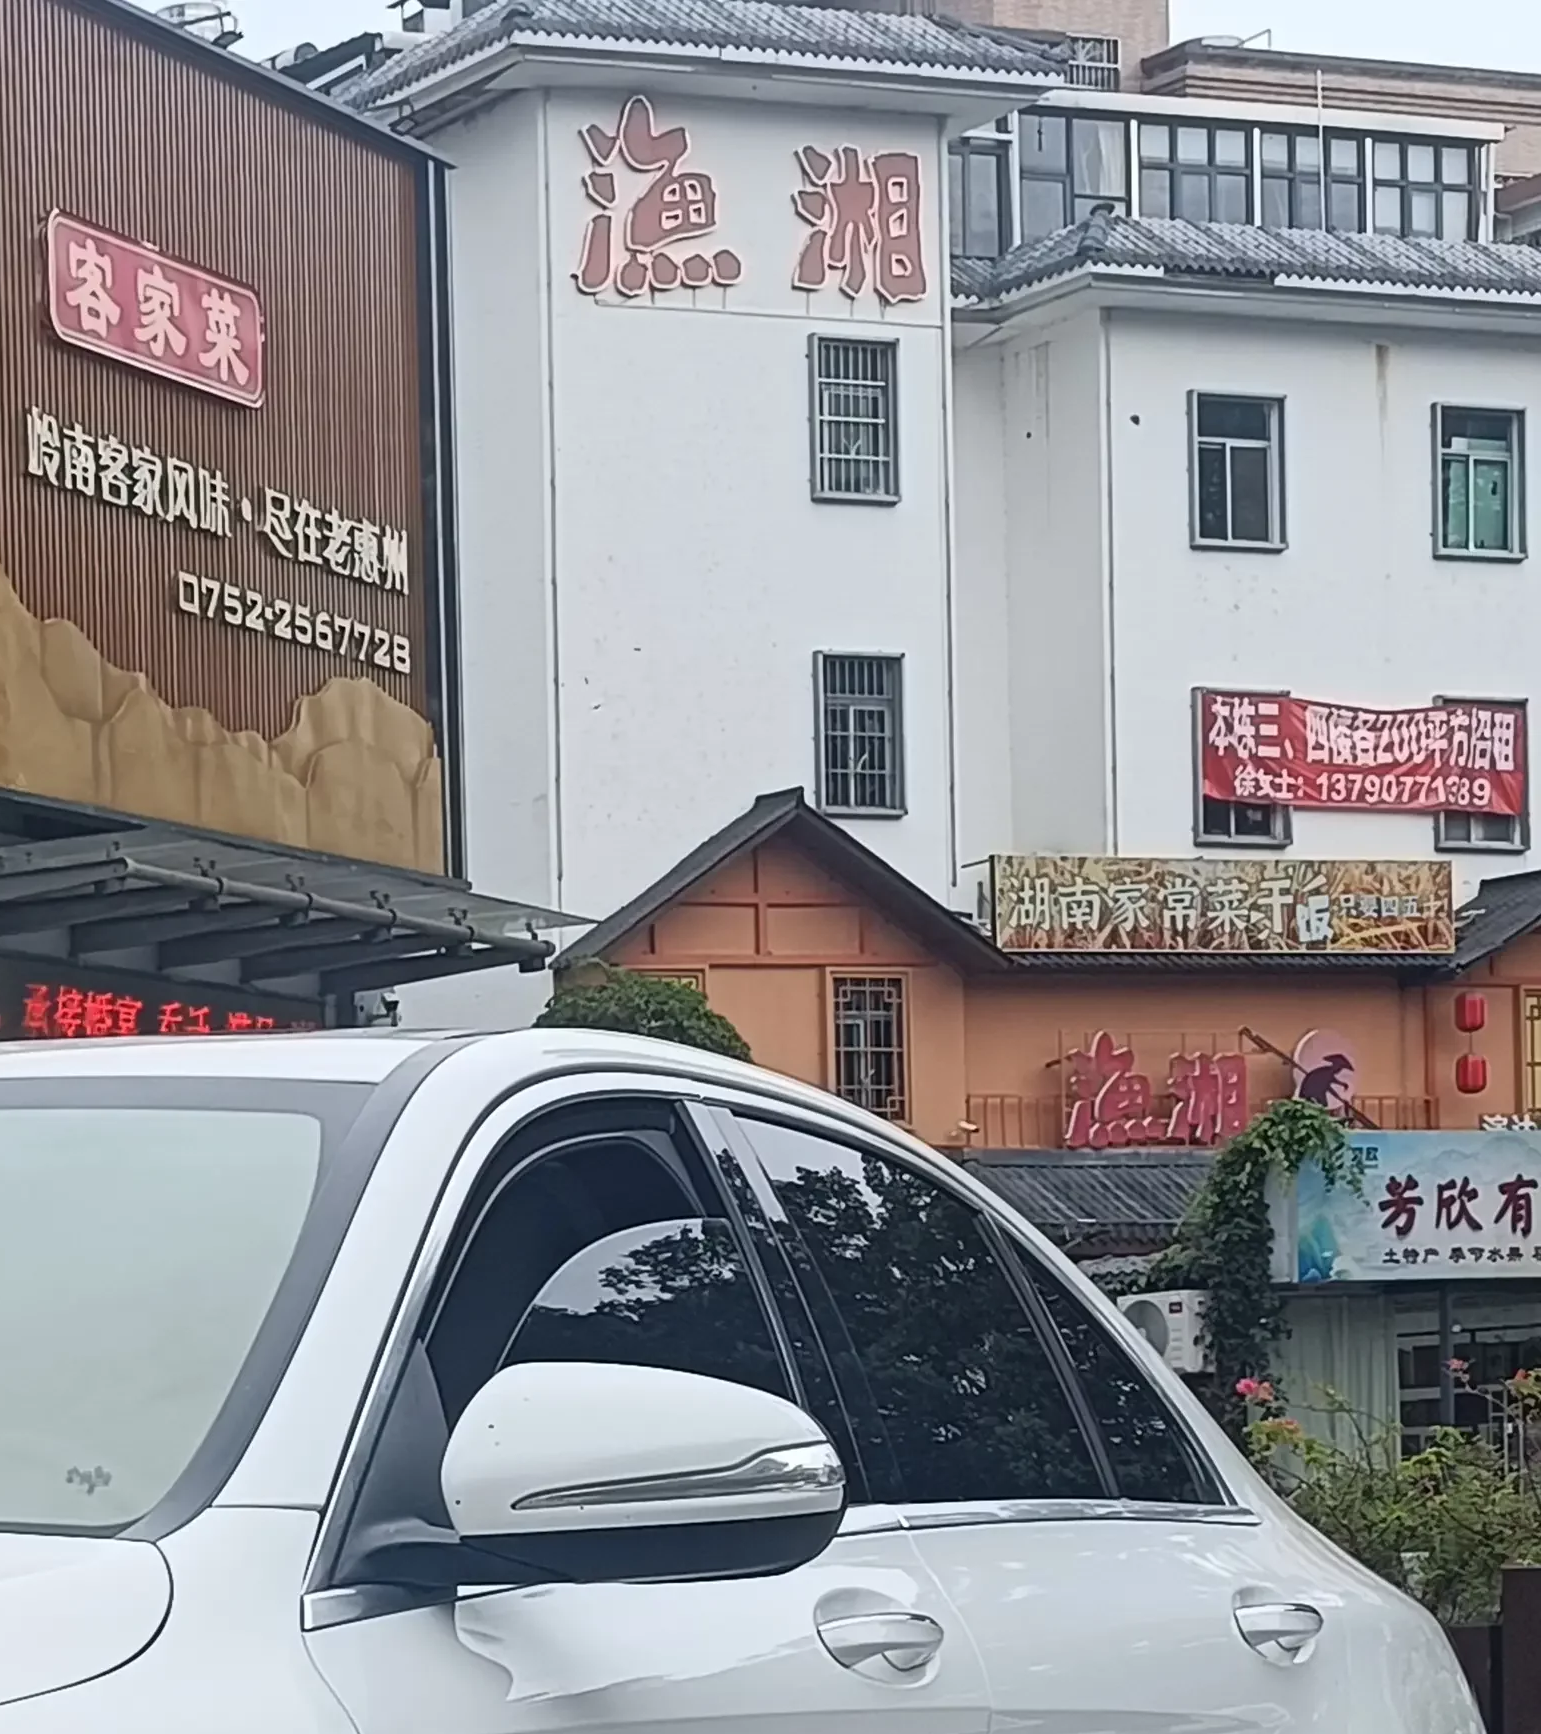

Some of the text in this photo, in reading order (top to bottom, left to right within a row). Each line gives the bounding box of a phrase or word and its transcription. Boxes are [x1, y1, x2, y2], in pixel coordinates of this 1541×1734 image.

[65, 238, 250, 386] 客家菜
[1378, 1173, 1539, 1239] 芳欣有
